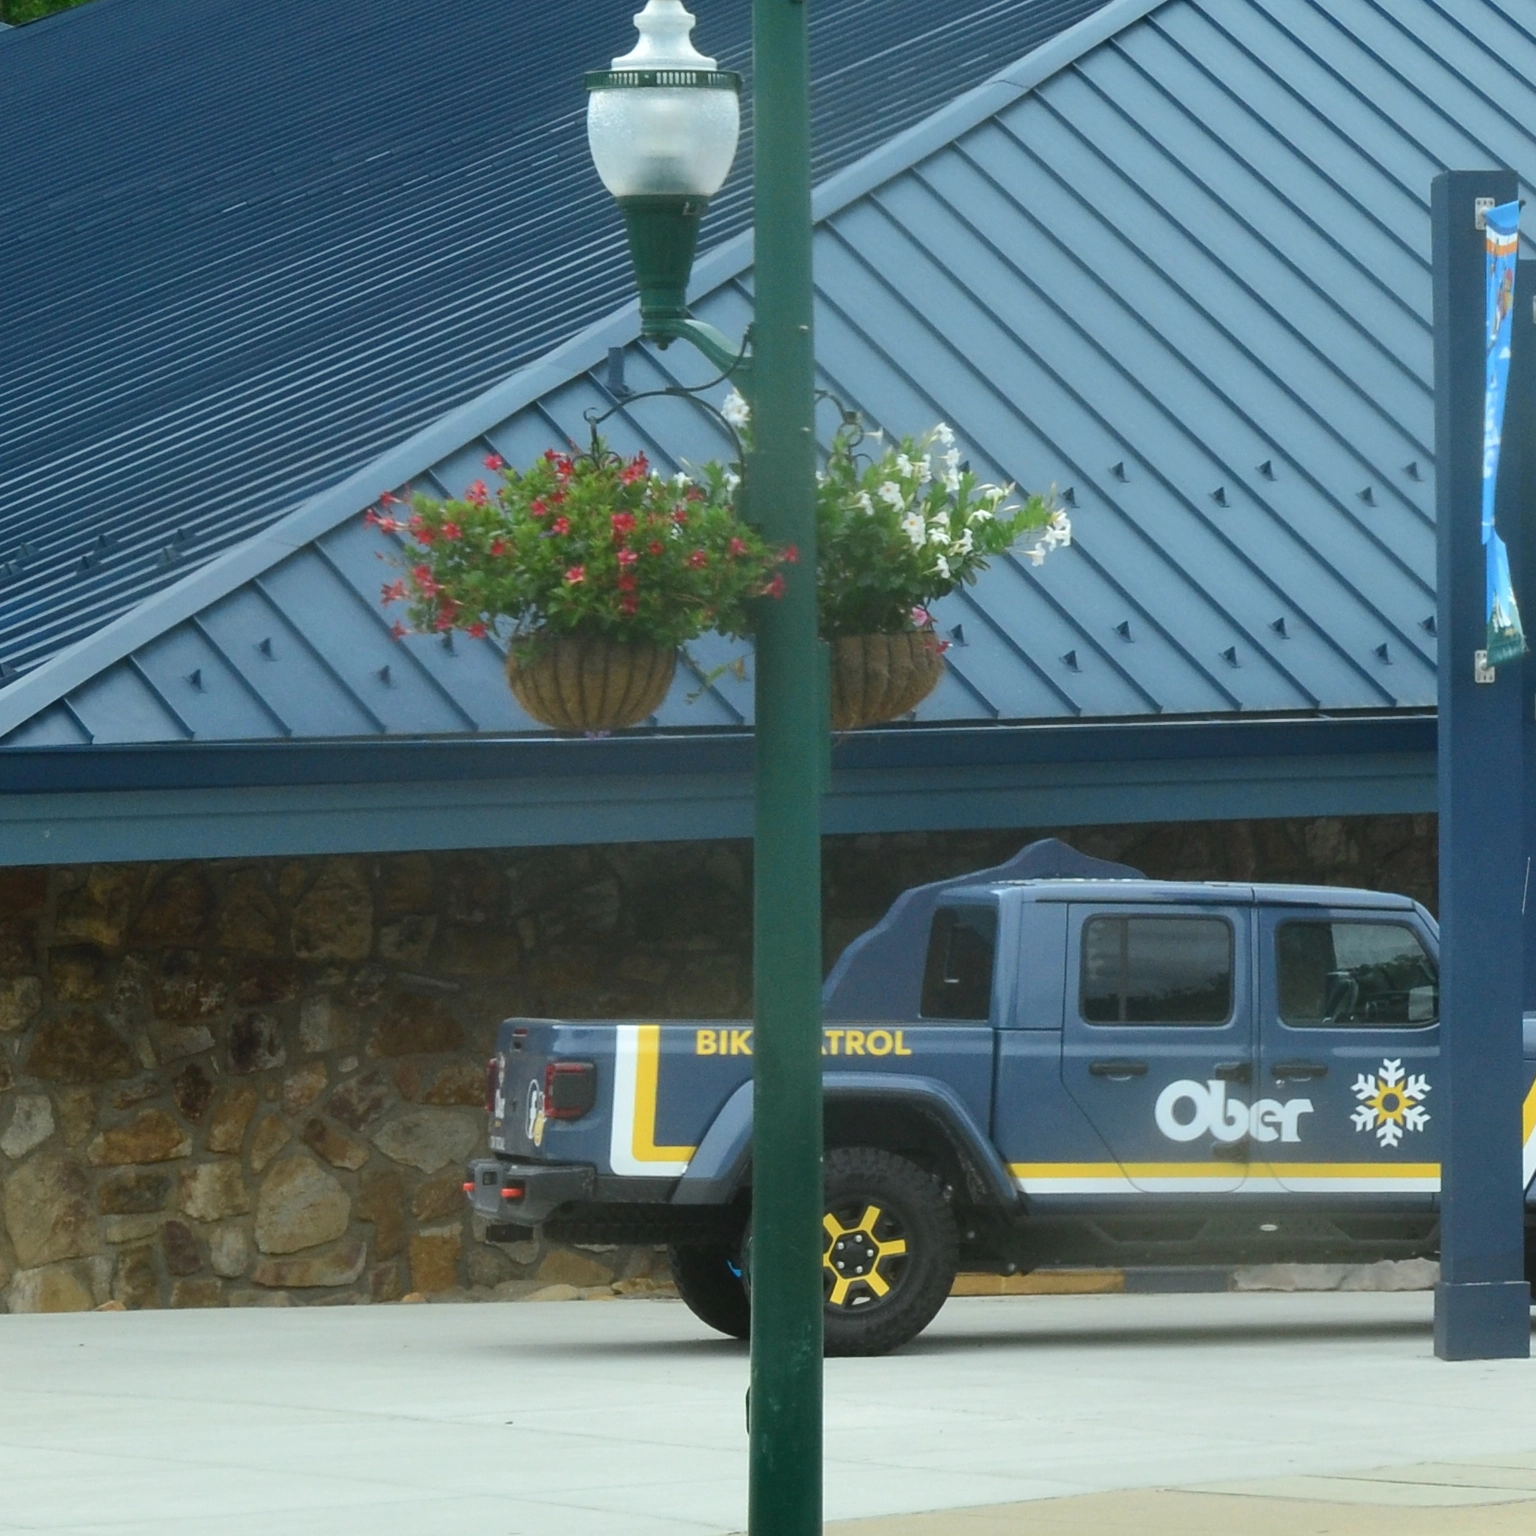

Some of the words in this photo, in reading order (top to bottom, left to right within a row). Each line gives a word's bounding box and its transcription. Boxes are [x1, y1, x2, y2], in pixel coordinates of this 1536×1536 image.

[696, 1030, 754, 1056] BIK
[821, 1030, 912, 1056] TROL
[1154, 1079, 1315, 1143] Ober
